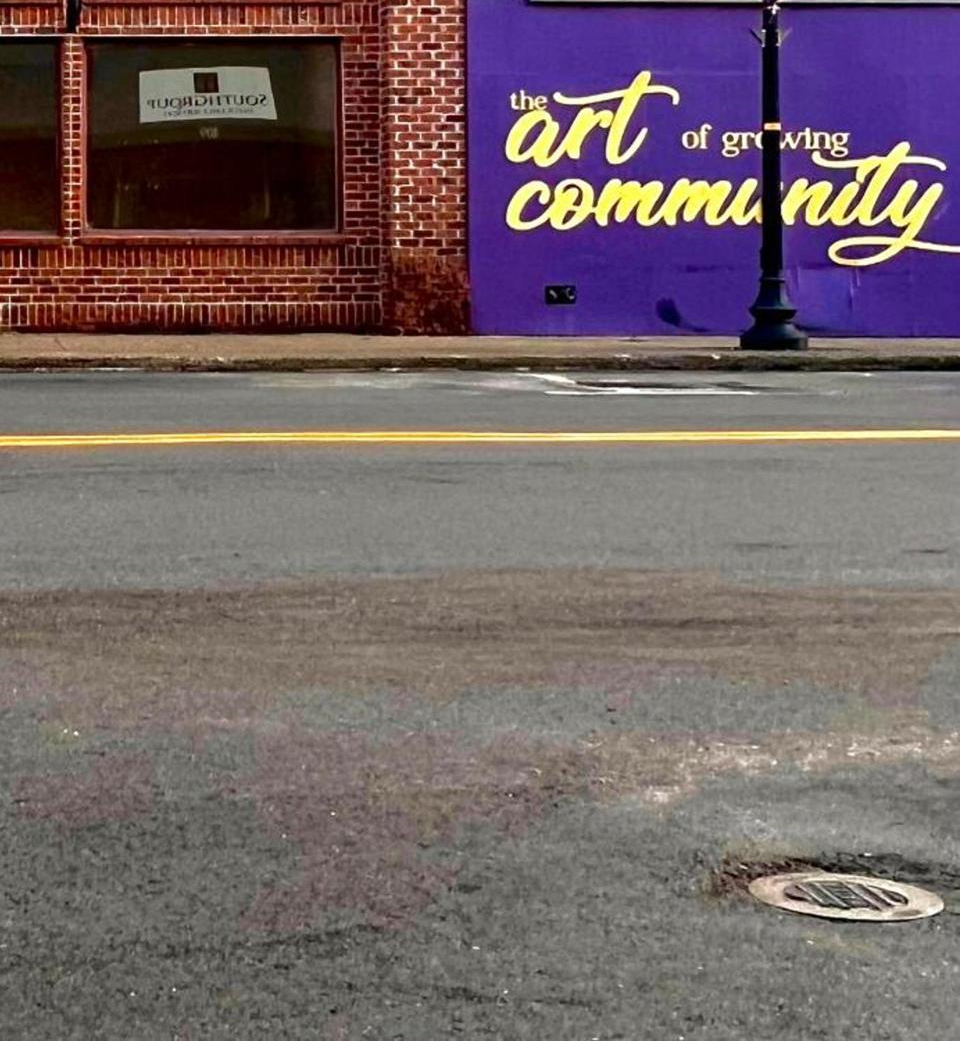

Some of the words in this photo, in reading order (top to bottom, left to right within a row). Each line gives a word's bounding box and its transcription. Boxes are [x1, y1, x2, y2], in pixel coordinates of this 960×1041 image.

[505, 70, 680, 167] art
[510, 90, 548, 110] the
[681, 123, 712, 149] of
[505, 141, 960, 266] community
